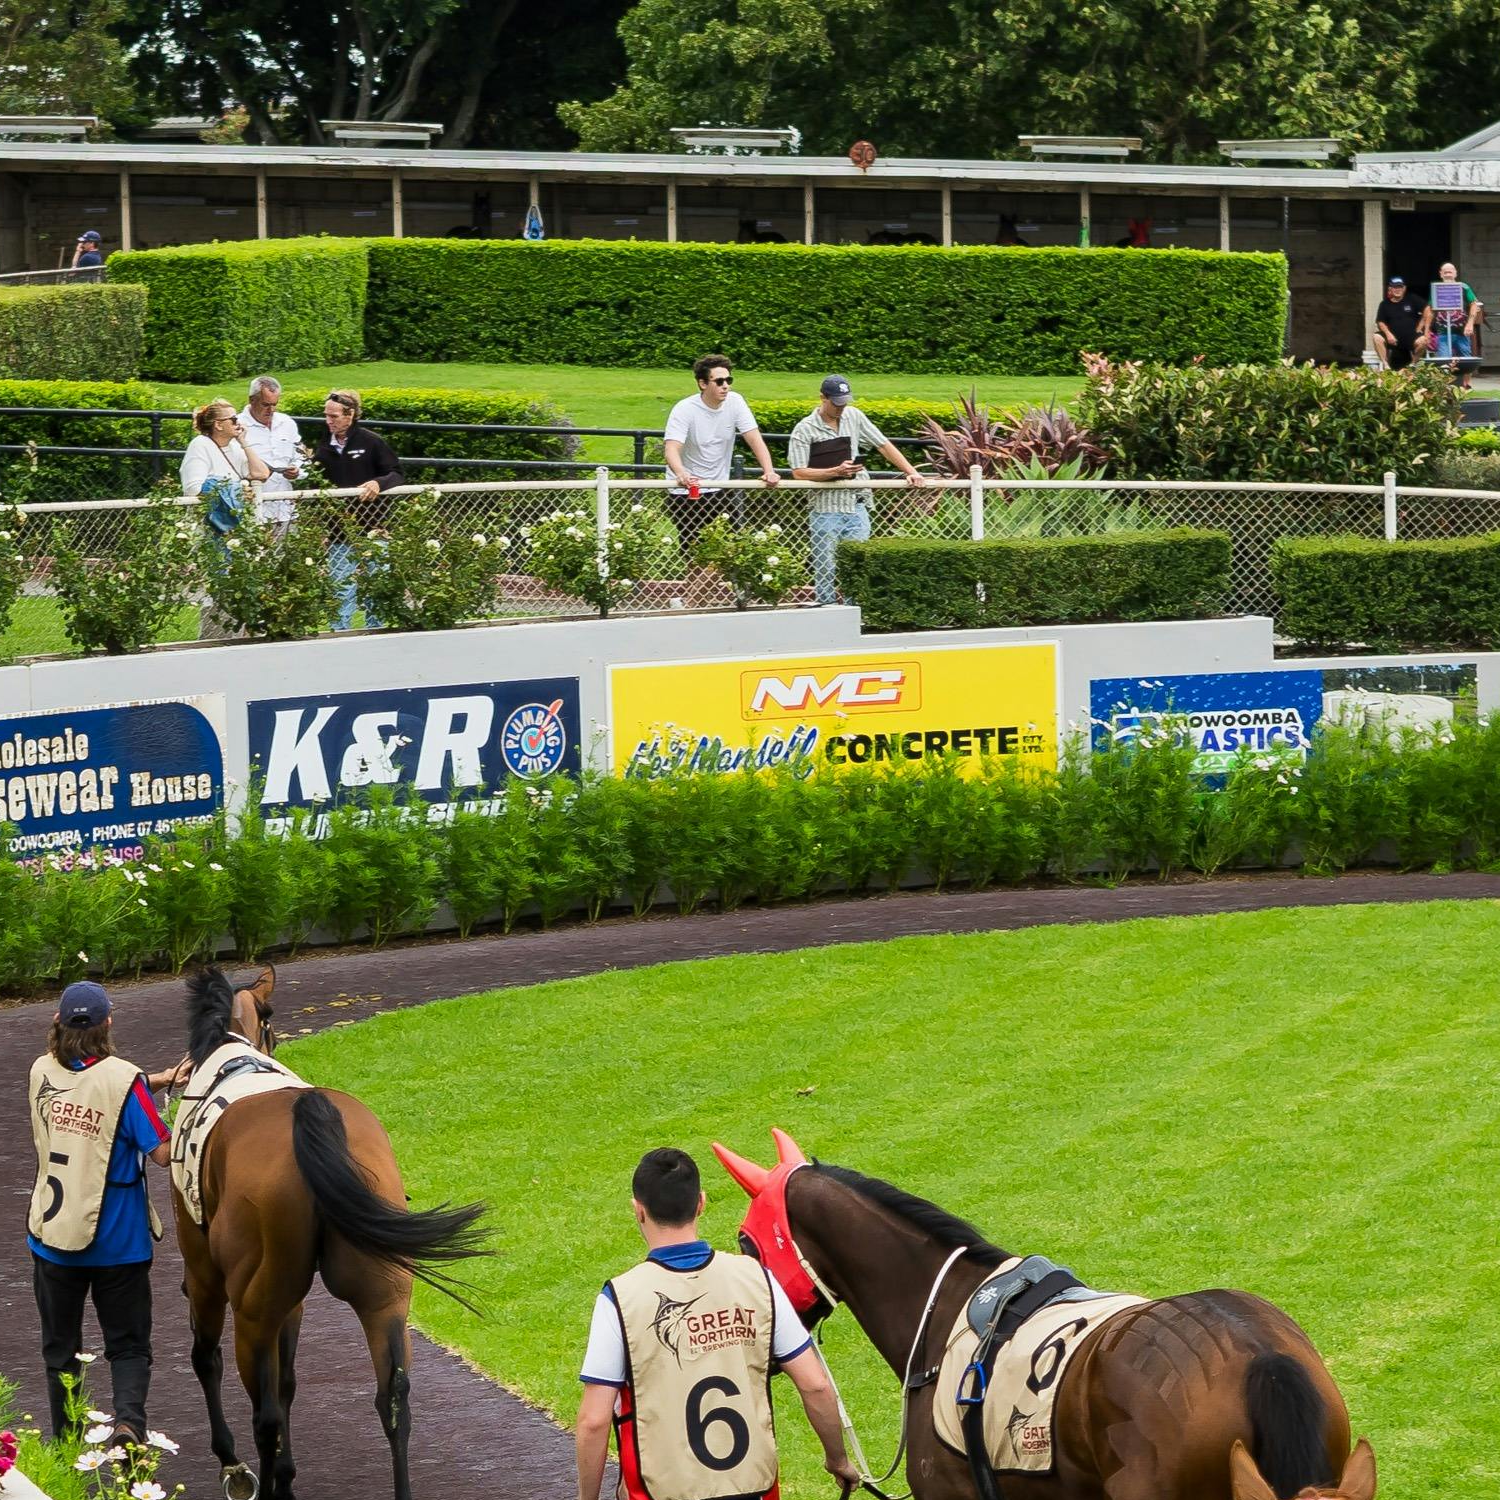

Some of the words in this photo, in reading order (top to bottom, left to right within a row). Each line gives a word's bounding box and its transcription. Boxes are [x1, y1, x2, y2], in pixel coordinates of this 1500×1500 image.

[750, 670, 906, 712] NMC
[505, 709, 561, 749] PLUMBING
[1185, 712, 1298, 729] OWOOMBA
[261, 696, 494, 804] K&R
[517, 752, 552, 773] PLUS
[825, 727, 1019, 764] CONCRETE
[130, 772, 212, 807] House
[93, 822, 136, 842] PHONE
[137, 820, 152, 838] 07
[51, 1100, 105, 1125] GREAT
[43, 1151, 70, 1224] 5
[686, 1307, 756, 1334] GREAT
[689, 1326, 757, 1347] NORTHERN
[701, 1339, 740, 1353] BREWING
[1026, 1316, 1088, 1397] 6
[685, 1375, 750, 1471] 6
